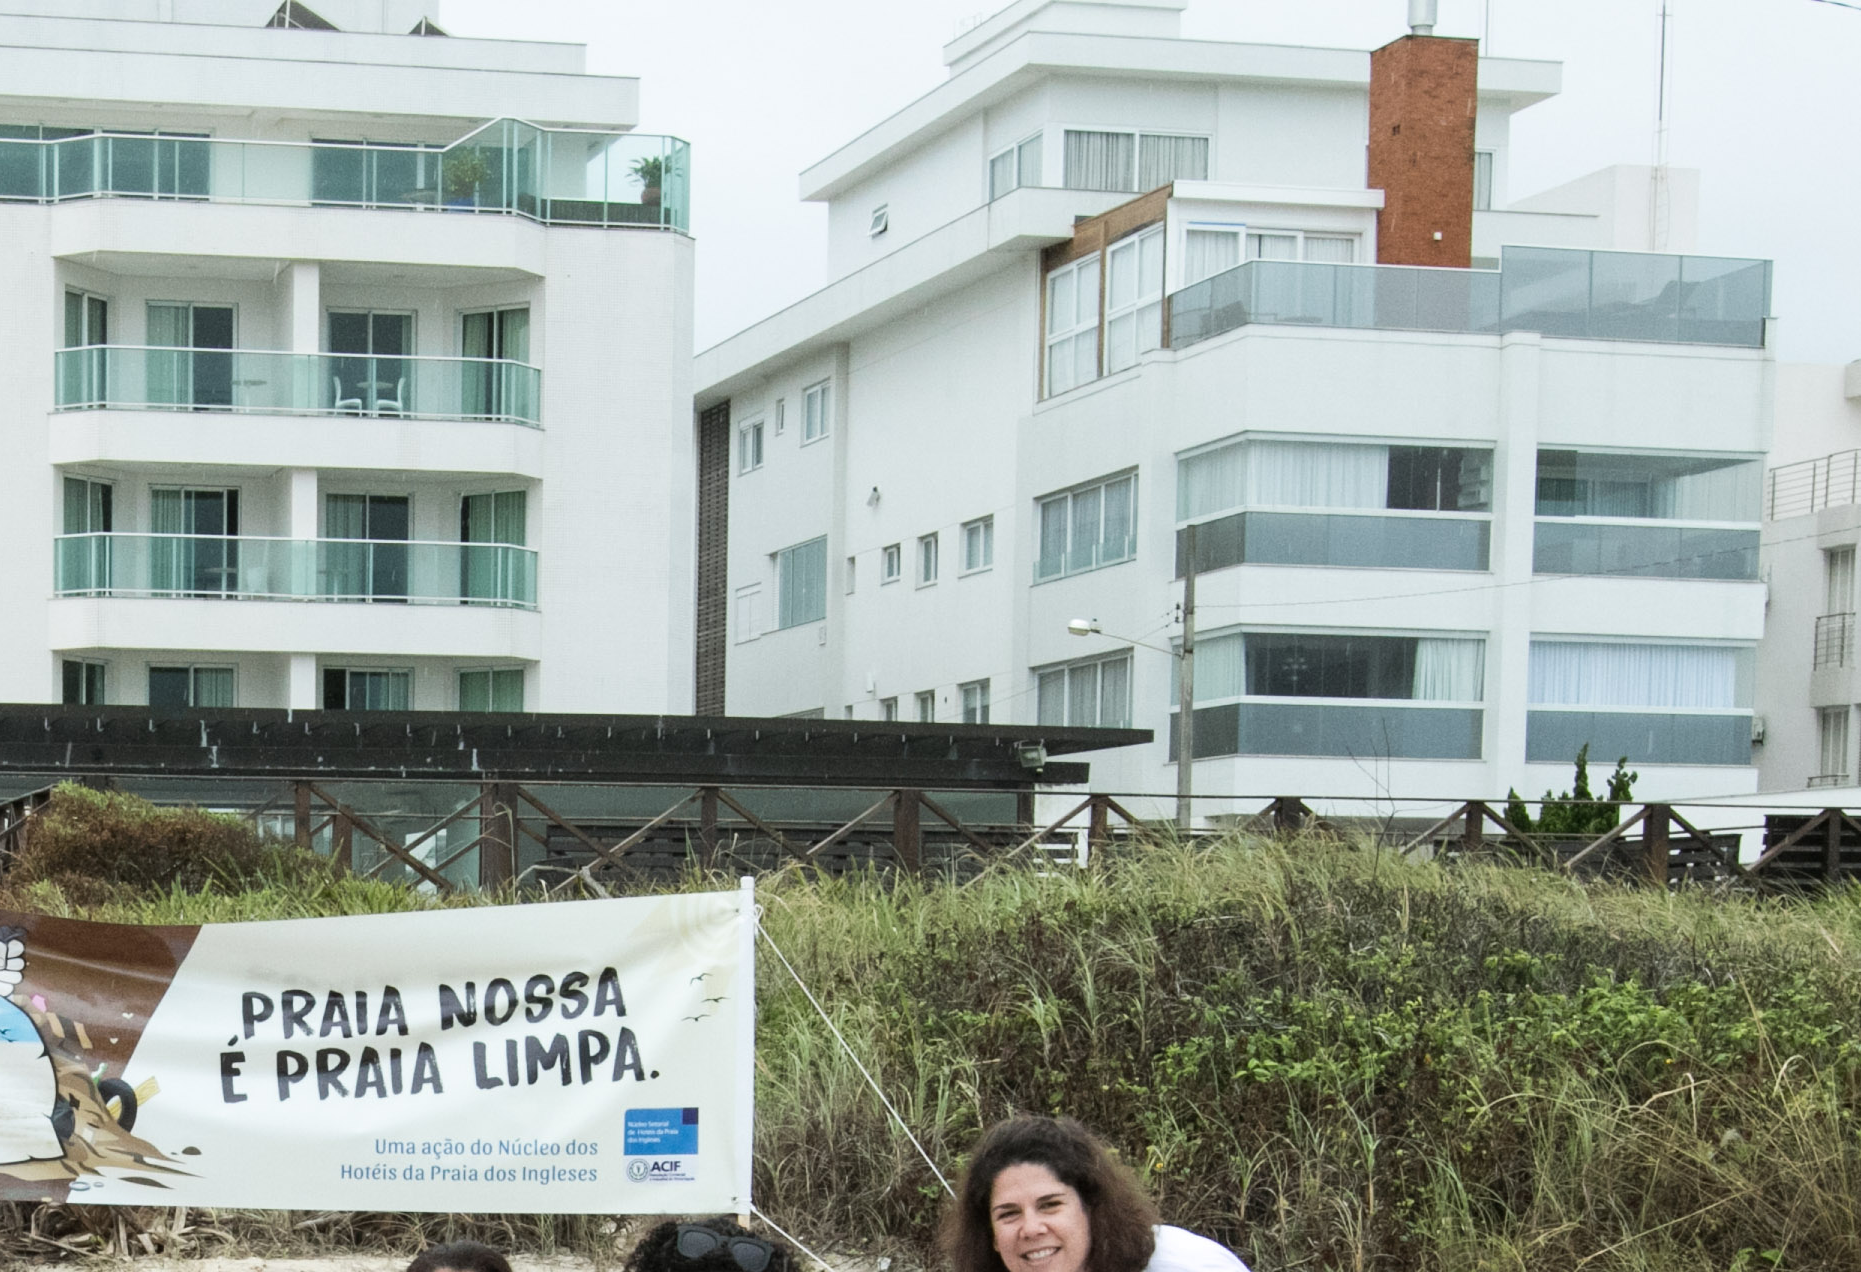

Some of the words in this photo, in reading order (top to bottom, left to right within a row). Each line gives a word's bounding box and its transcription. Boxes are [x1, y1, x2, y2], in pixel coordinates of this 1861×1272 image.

[242, 985, 410, 1040] PRAIA
[439, 966, 627, 1031] NOSSA
[220, 1034, 248, 1103] É
[276, 1041, 444, 1101] PRAIA
[472, 1026, 660, 1090] LIMPA.
[375, 1138, 416, 1155] Uma
[421, 1138, 465, 1160] ação
[470, 1138, 493, 1156] do
[498, 1138, 561, 1156] Núcleo
[565, 1139, 599, 1156] dos
[340, 1163, 398, 1181] Hotéis
[402, 1164, 425, 1181] da
[430, 1165, 479, 1182] Praia
[484, 1165, 517, 1182] dos
[522, 1165, 598, 1186] Ingleses
[650, 1160, 681, 1172] ACIF
